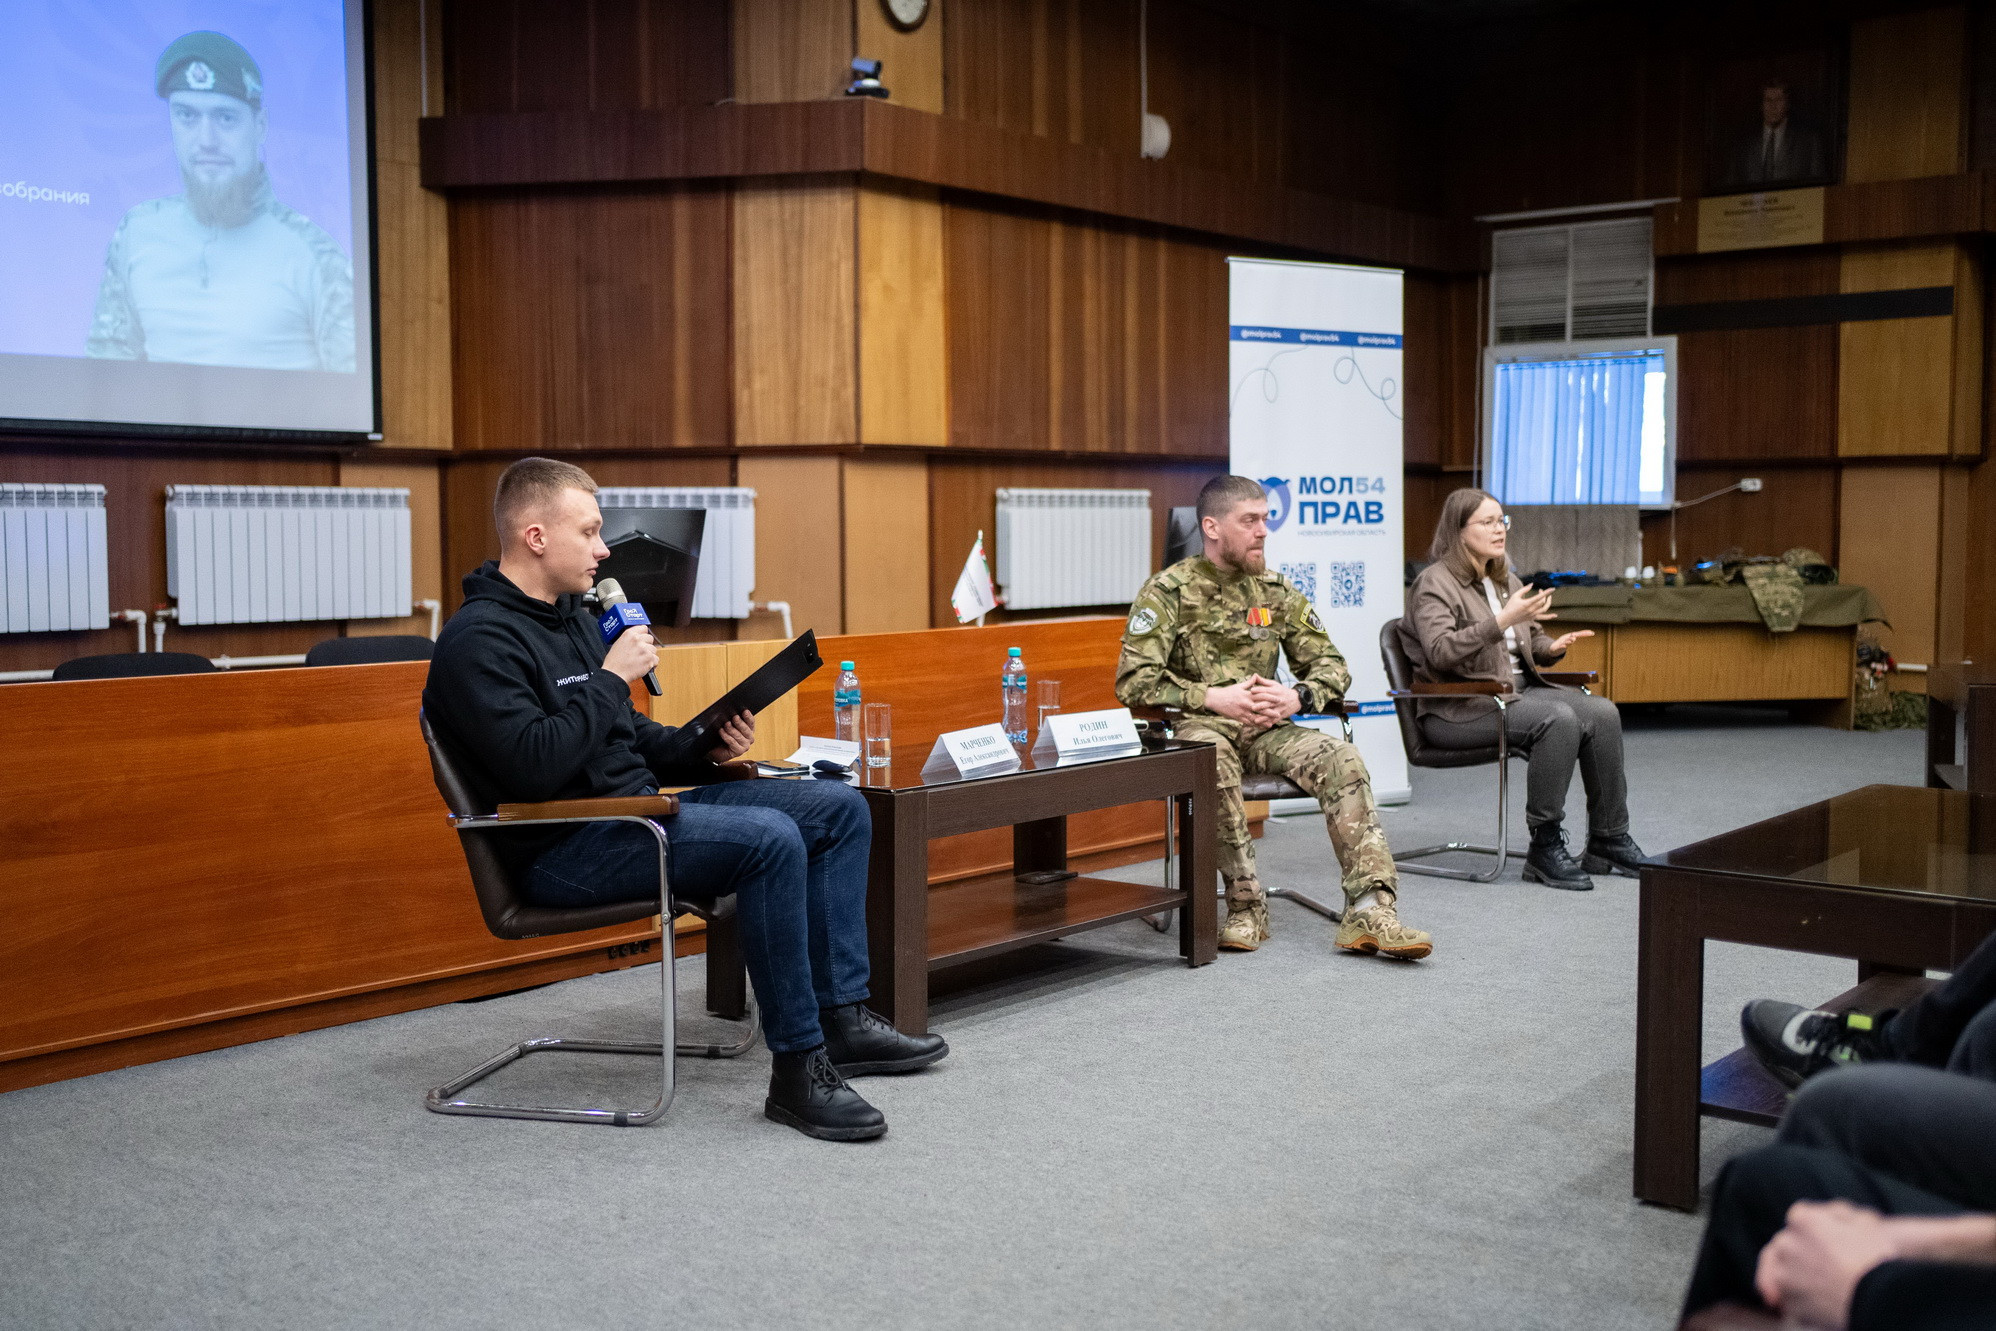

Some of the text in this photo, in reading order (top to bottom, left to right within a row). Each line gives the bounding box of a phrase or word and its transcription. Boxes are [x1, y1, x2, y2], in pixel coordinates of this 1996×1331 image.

[0, 181, 90, 205] обрания
[1299, 501, 1384, 525] ПРАВ
[1079, 720, 1109, 732] РОДИН
[960, 735, 996, 751] МАРЧЕНКО
[1073, 733, 1124, 746] Илья Олегович
